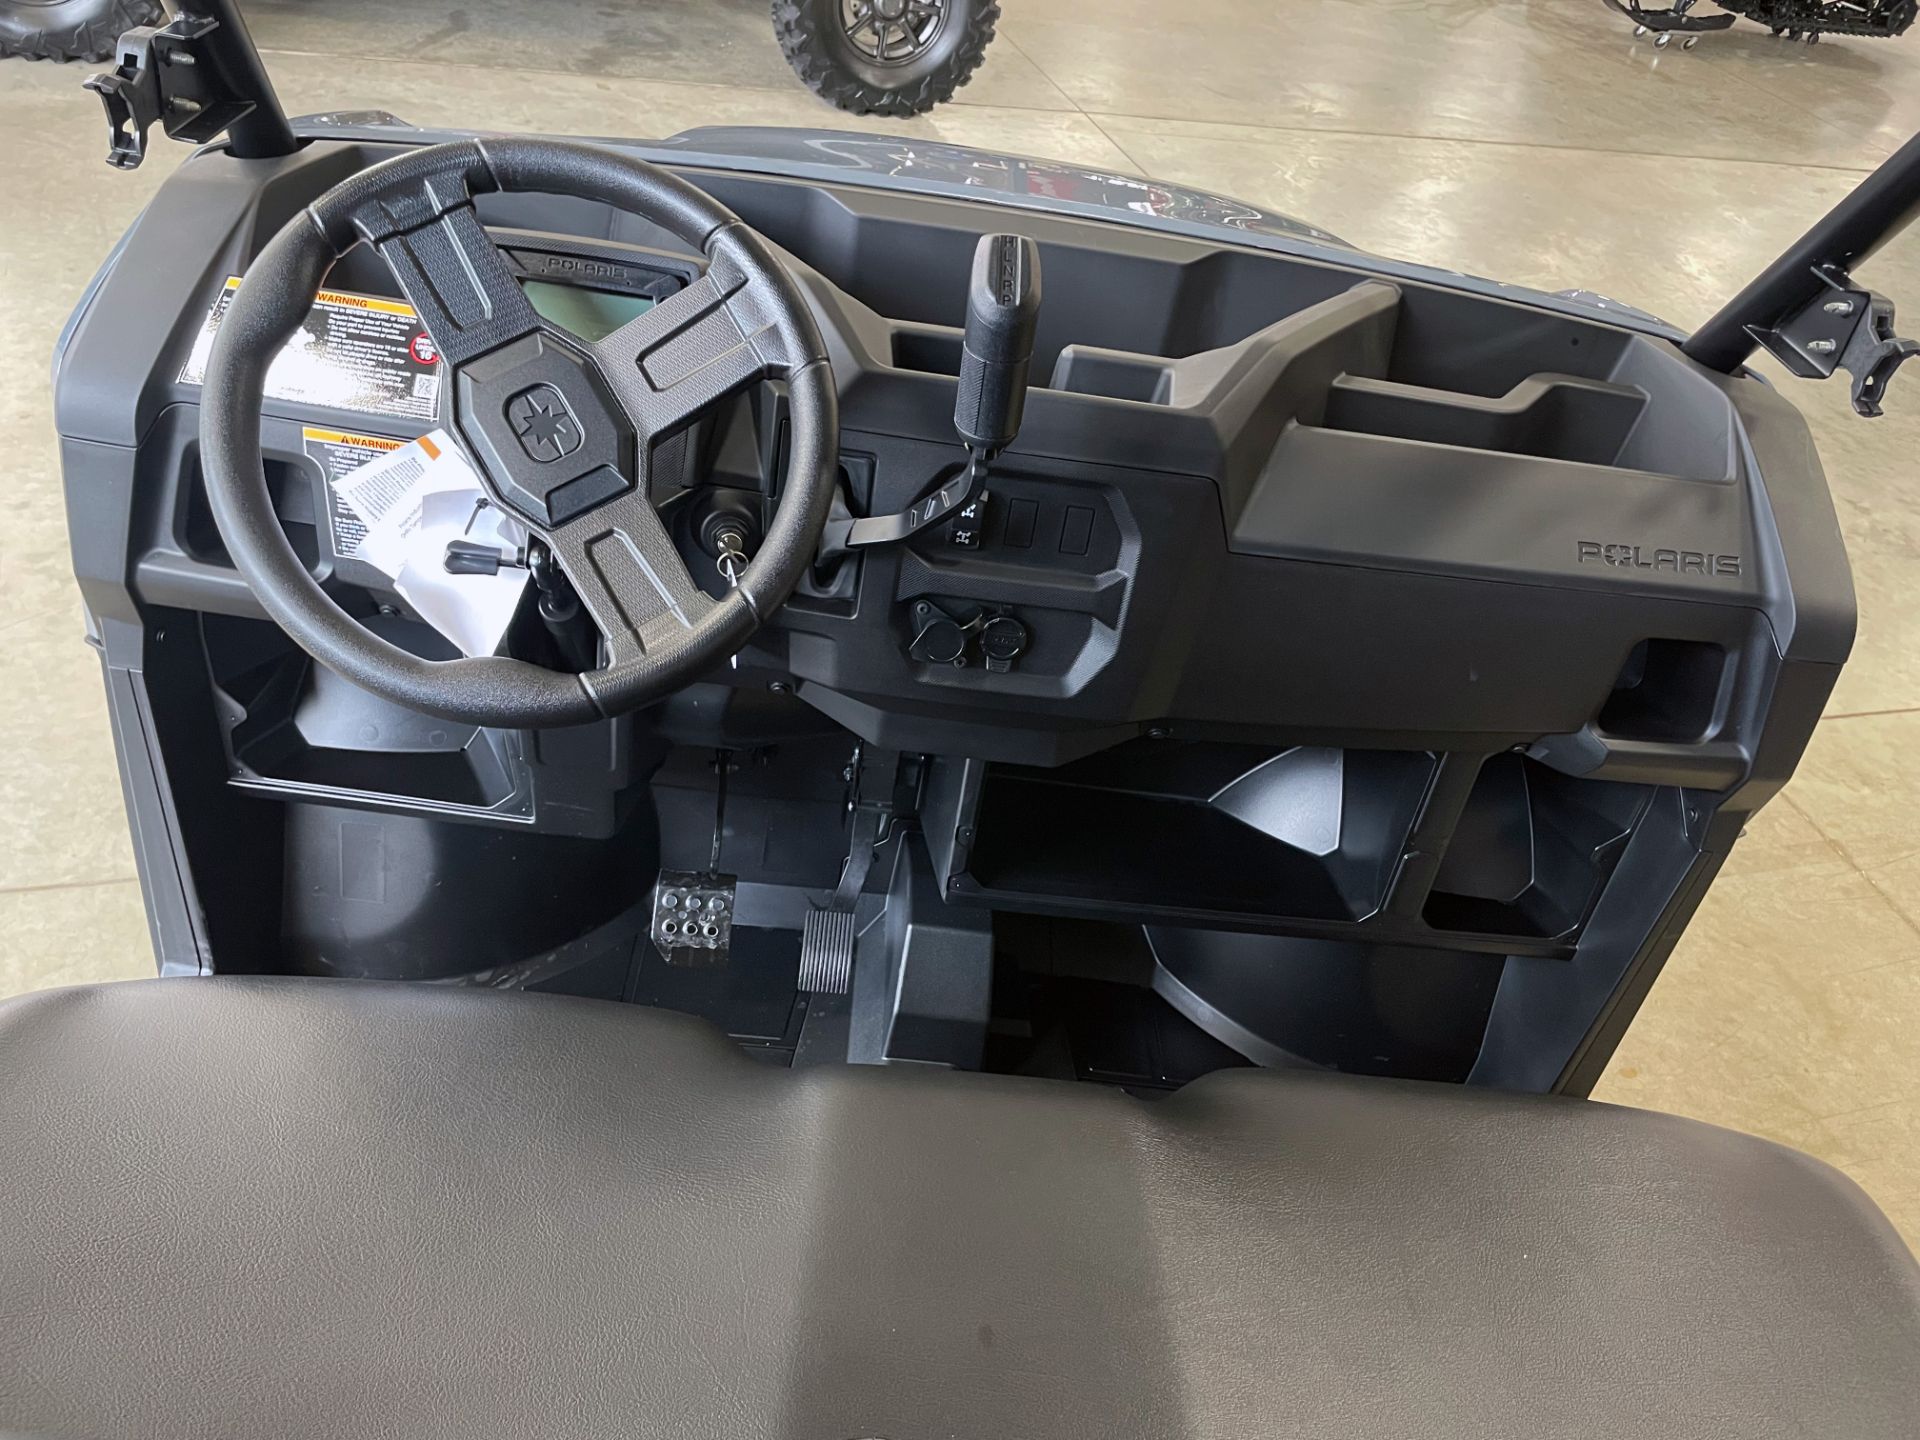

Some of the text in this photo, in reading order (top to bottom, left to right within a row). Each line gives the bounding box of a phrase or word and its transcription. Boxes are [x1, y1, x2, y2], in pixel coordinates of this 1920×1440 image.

[548, 258, 628, 279] POLARIS
[318, 293, 368, 308] WARNING
[346, 308, 368, 317] SEVERE
[369, 311, 390, 320] INJURY
[397, 316, 417, 325] DEATH
[420, 350, 433, 360] 16
[1577, 541, 1742, 577] POLARIS
